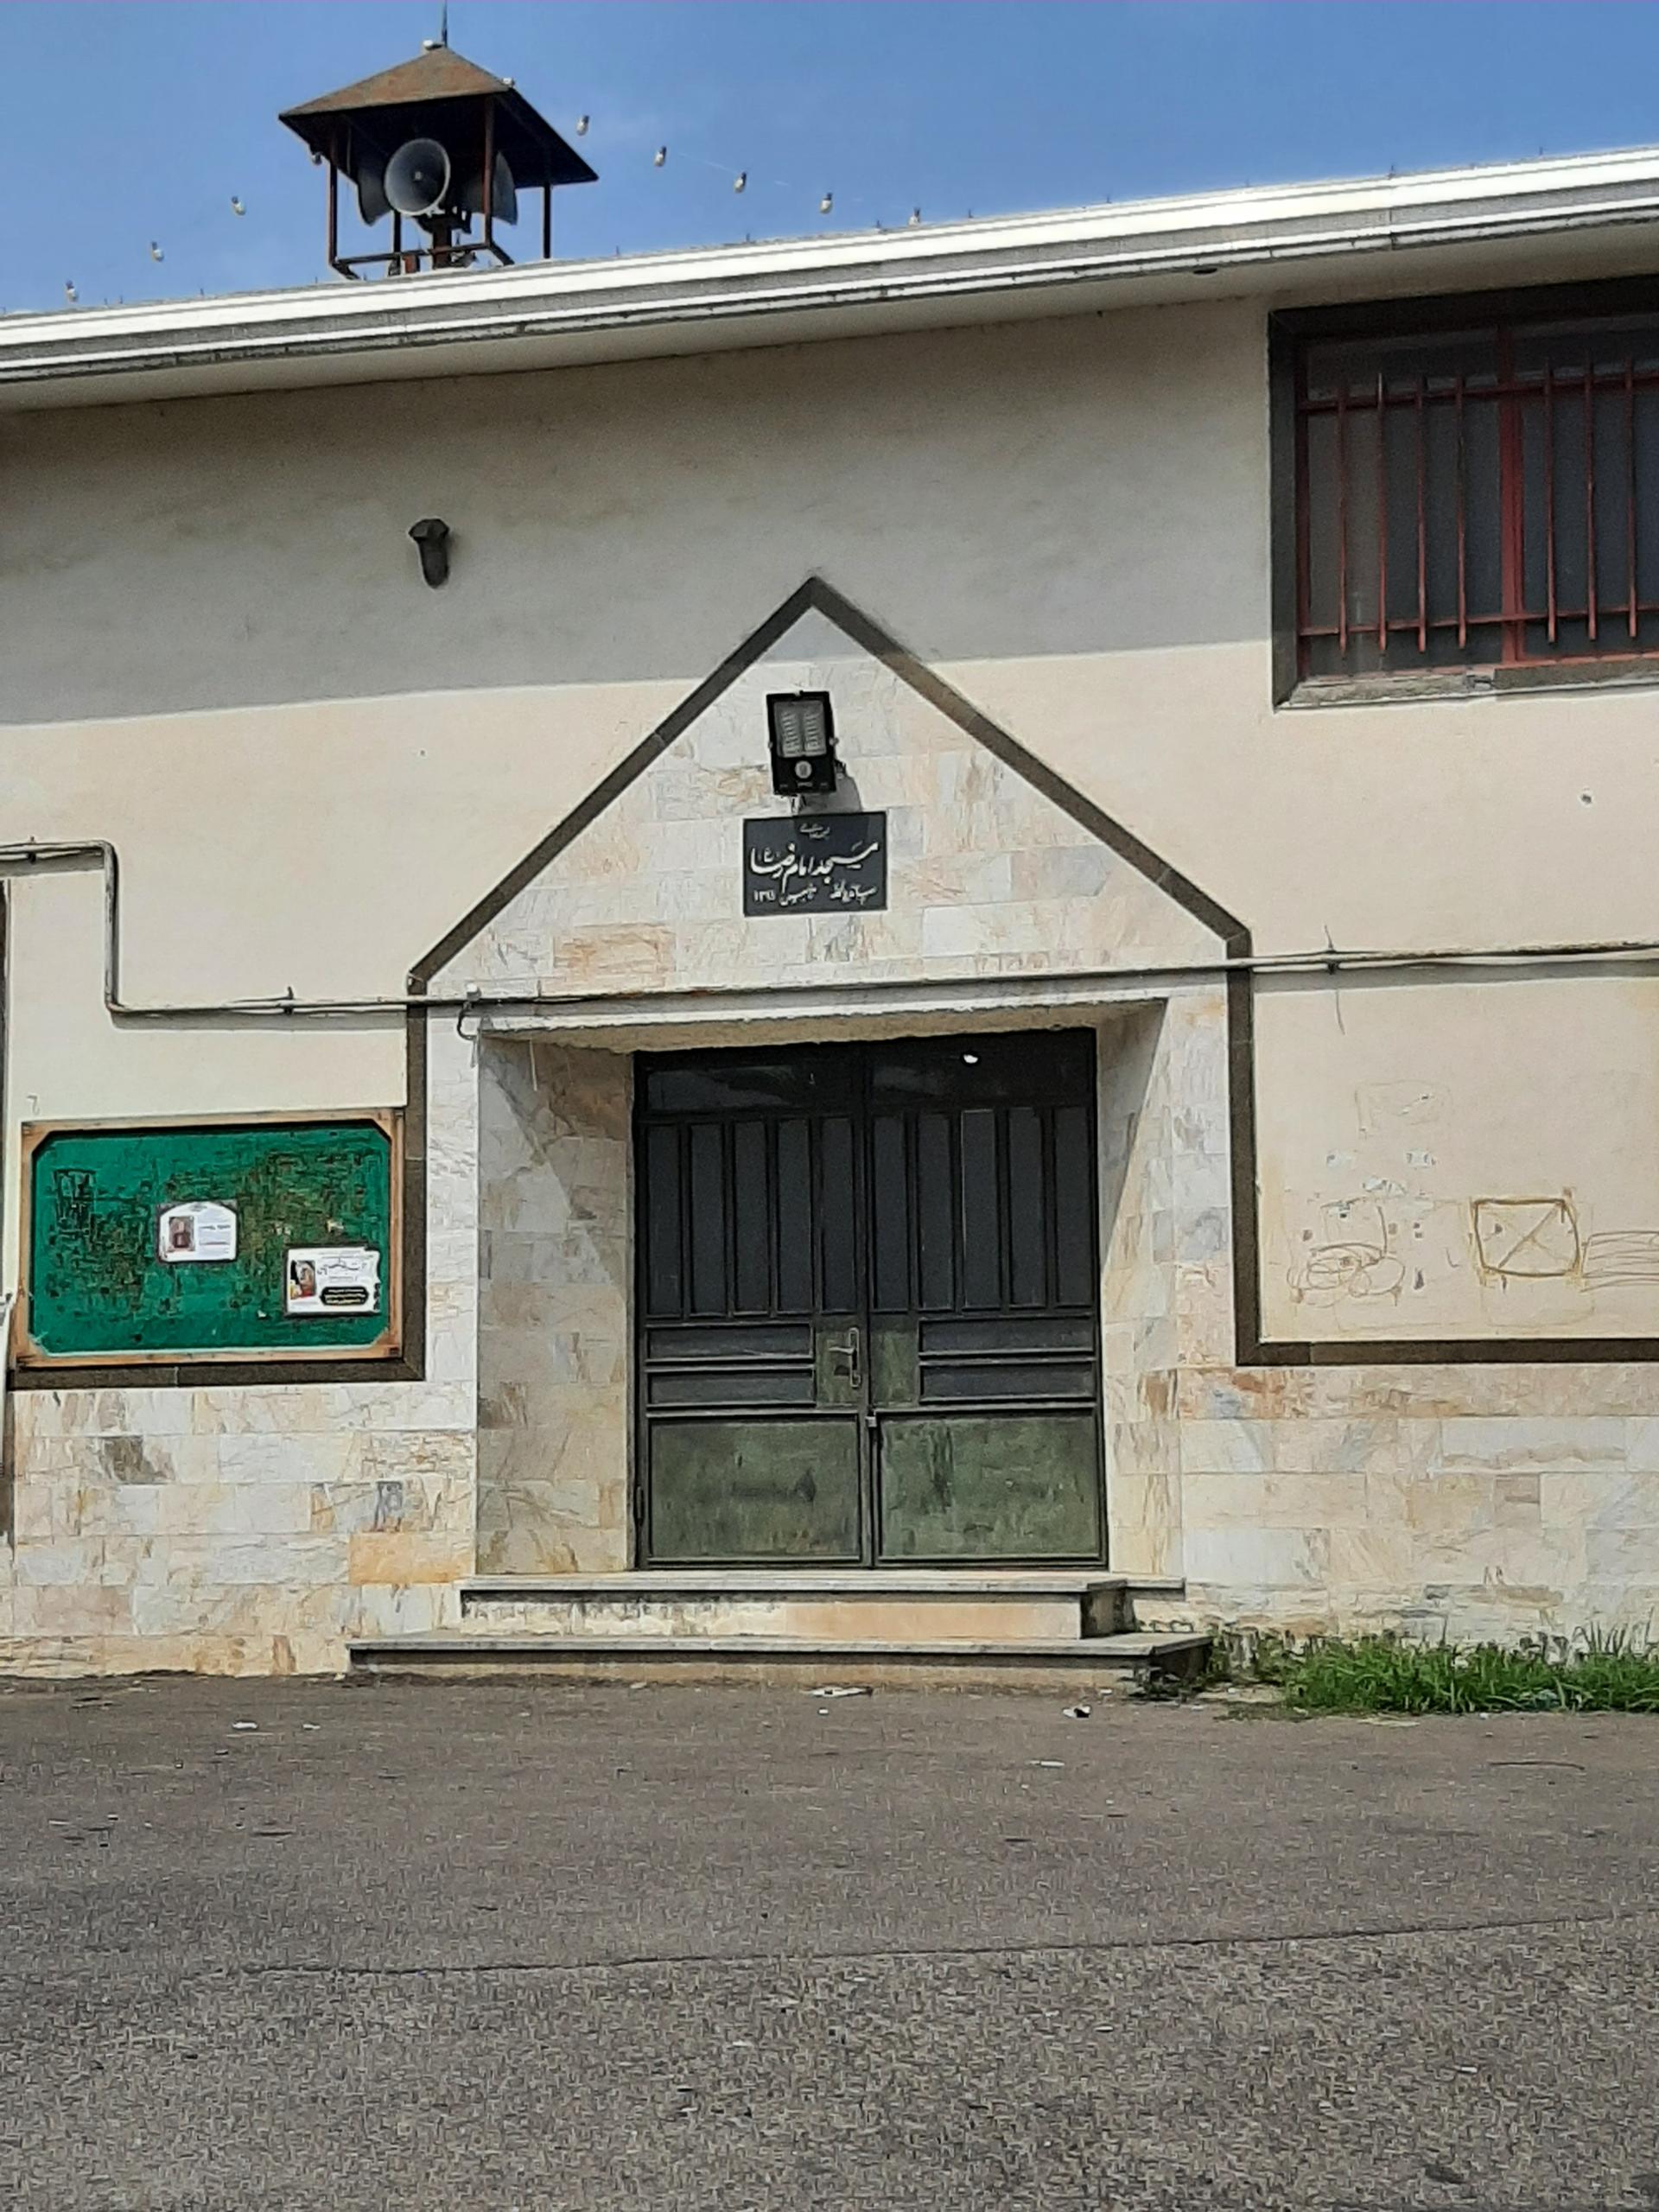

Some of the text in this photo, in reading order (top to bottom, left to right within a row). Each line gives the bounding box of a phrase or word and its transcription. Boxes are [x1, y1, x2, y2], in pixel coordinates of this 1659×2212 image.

[750, 842, 796, 880] رضا
[782, 855, 815, 893] امام
[810, 841, 879, 884] مسجد
